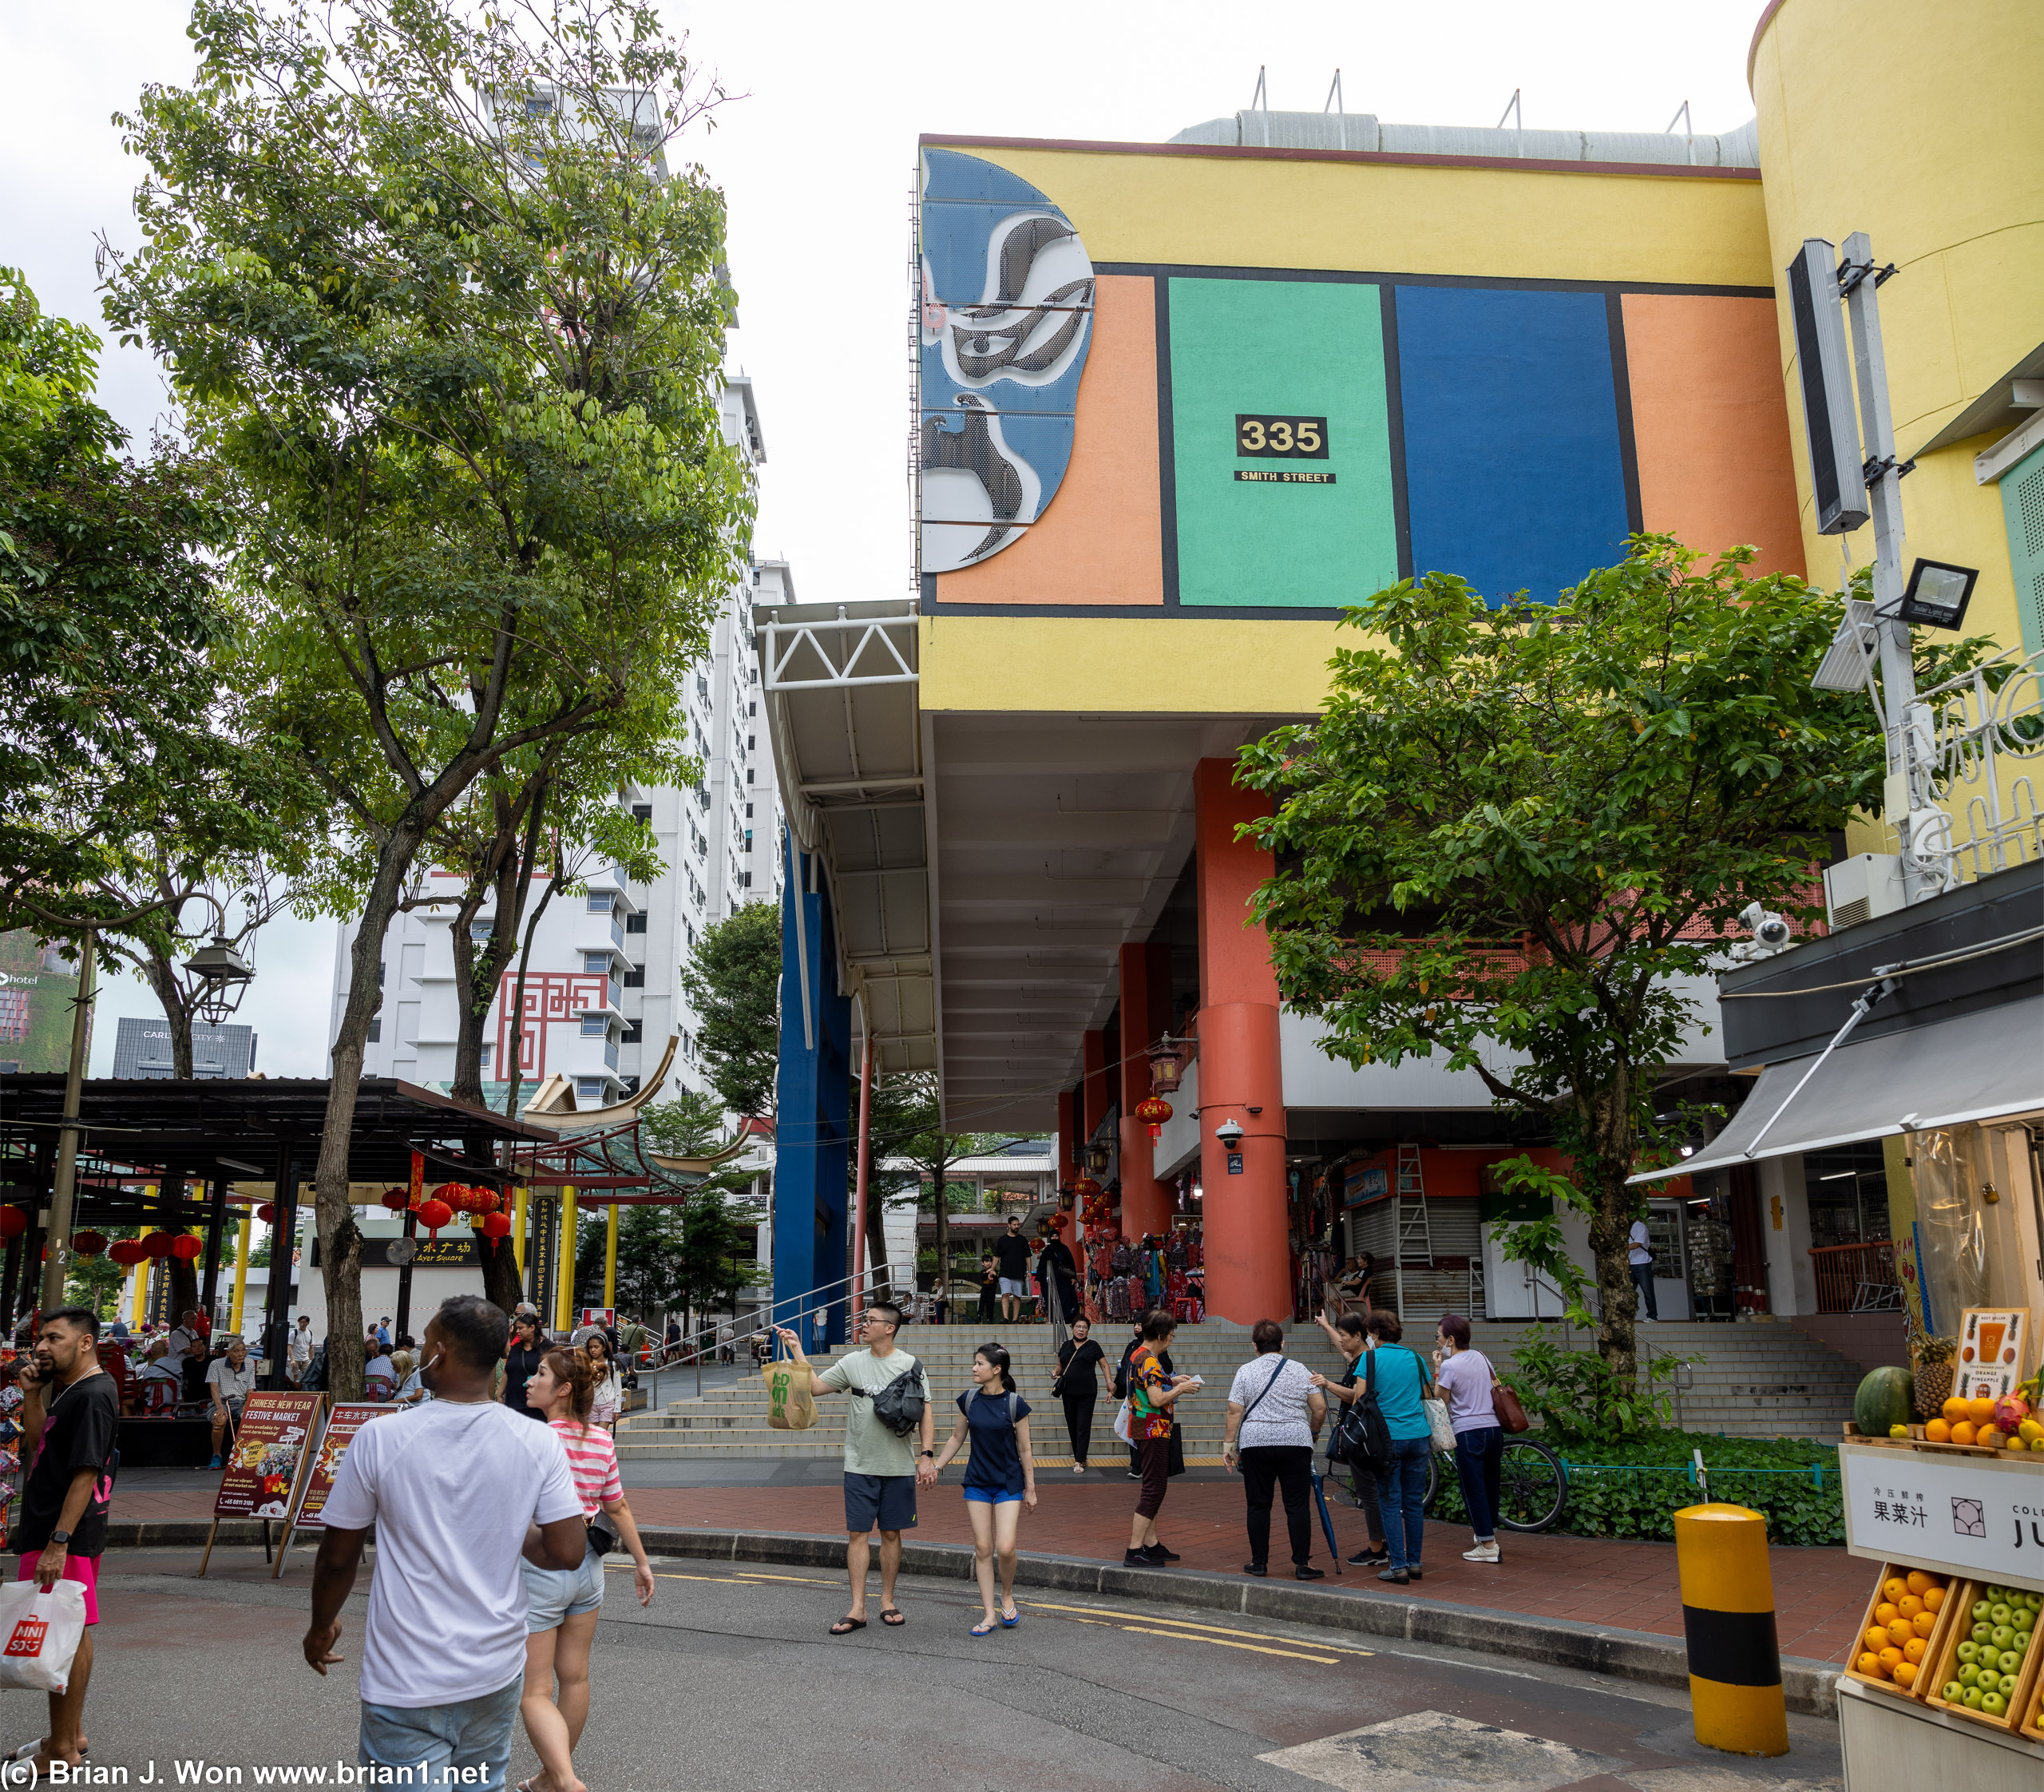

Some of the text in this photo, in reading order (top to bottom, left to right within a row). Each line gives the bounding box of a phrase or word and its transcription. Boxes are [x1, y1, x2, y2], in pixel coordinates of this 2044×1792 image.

[1242, 421, 1321, 452] 335
[1241, 471, 1329, 482] SMITH STREET
[10, 974, 38, 985] hotel
[57, 1250, 65, 1264] 2
[436, 1255, 464, 1263] Square
[249, 1398, 312, 1410] CHINESE NEW YEAR
[245, 1410, 300, 1422] FESTIVE MARKET
[1873, 1487, 1923, 1502] 冷压鲜榨
[1874, 1501, 1927, 1528] 果菜汁
